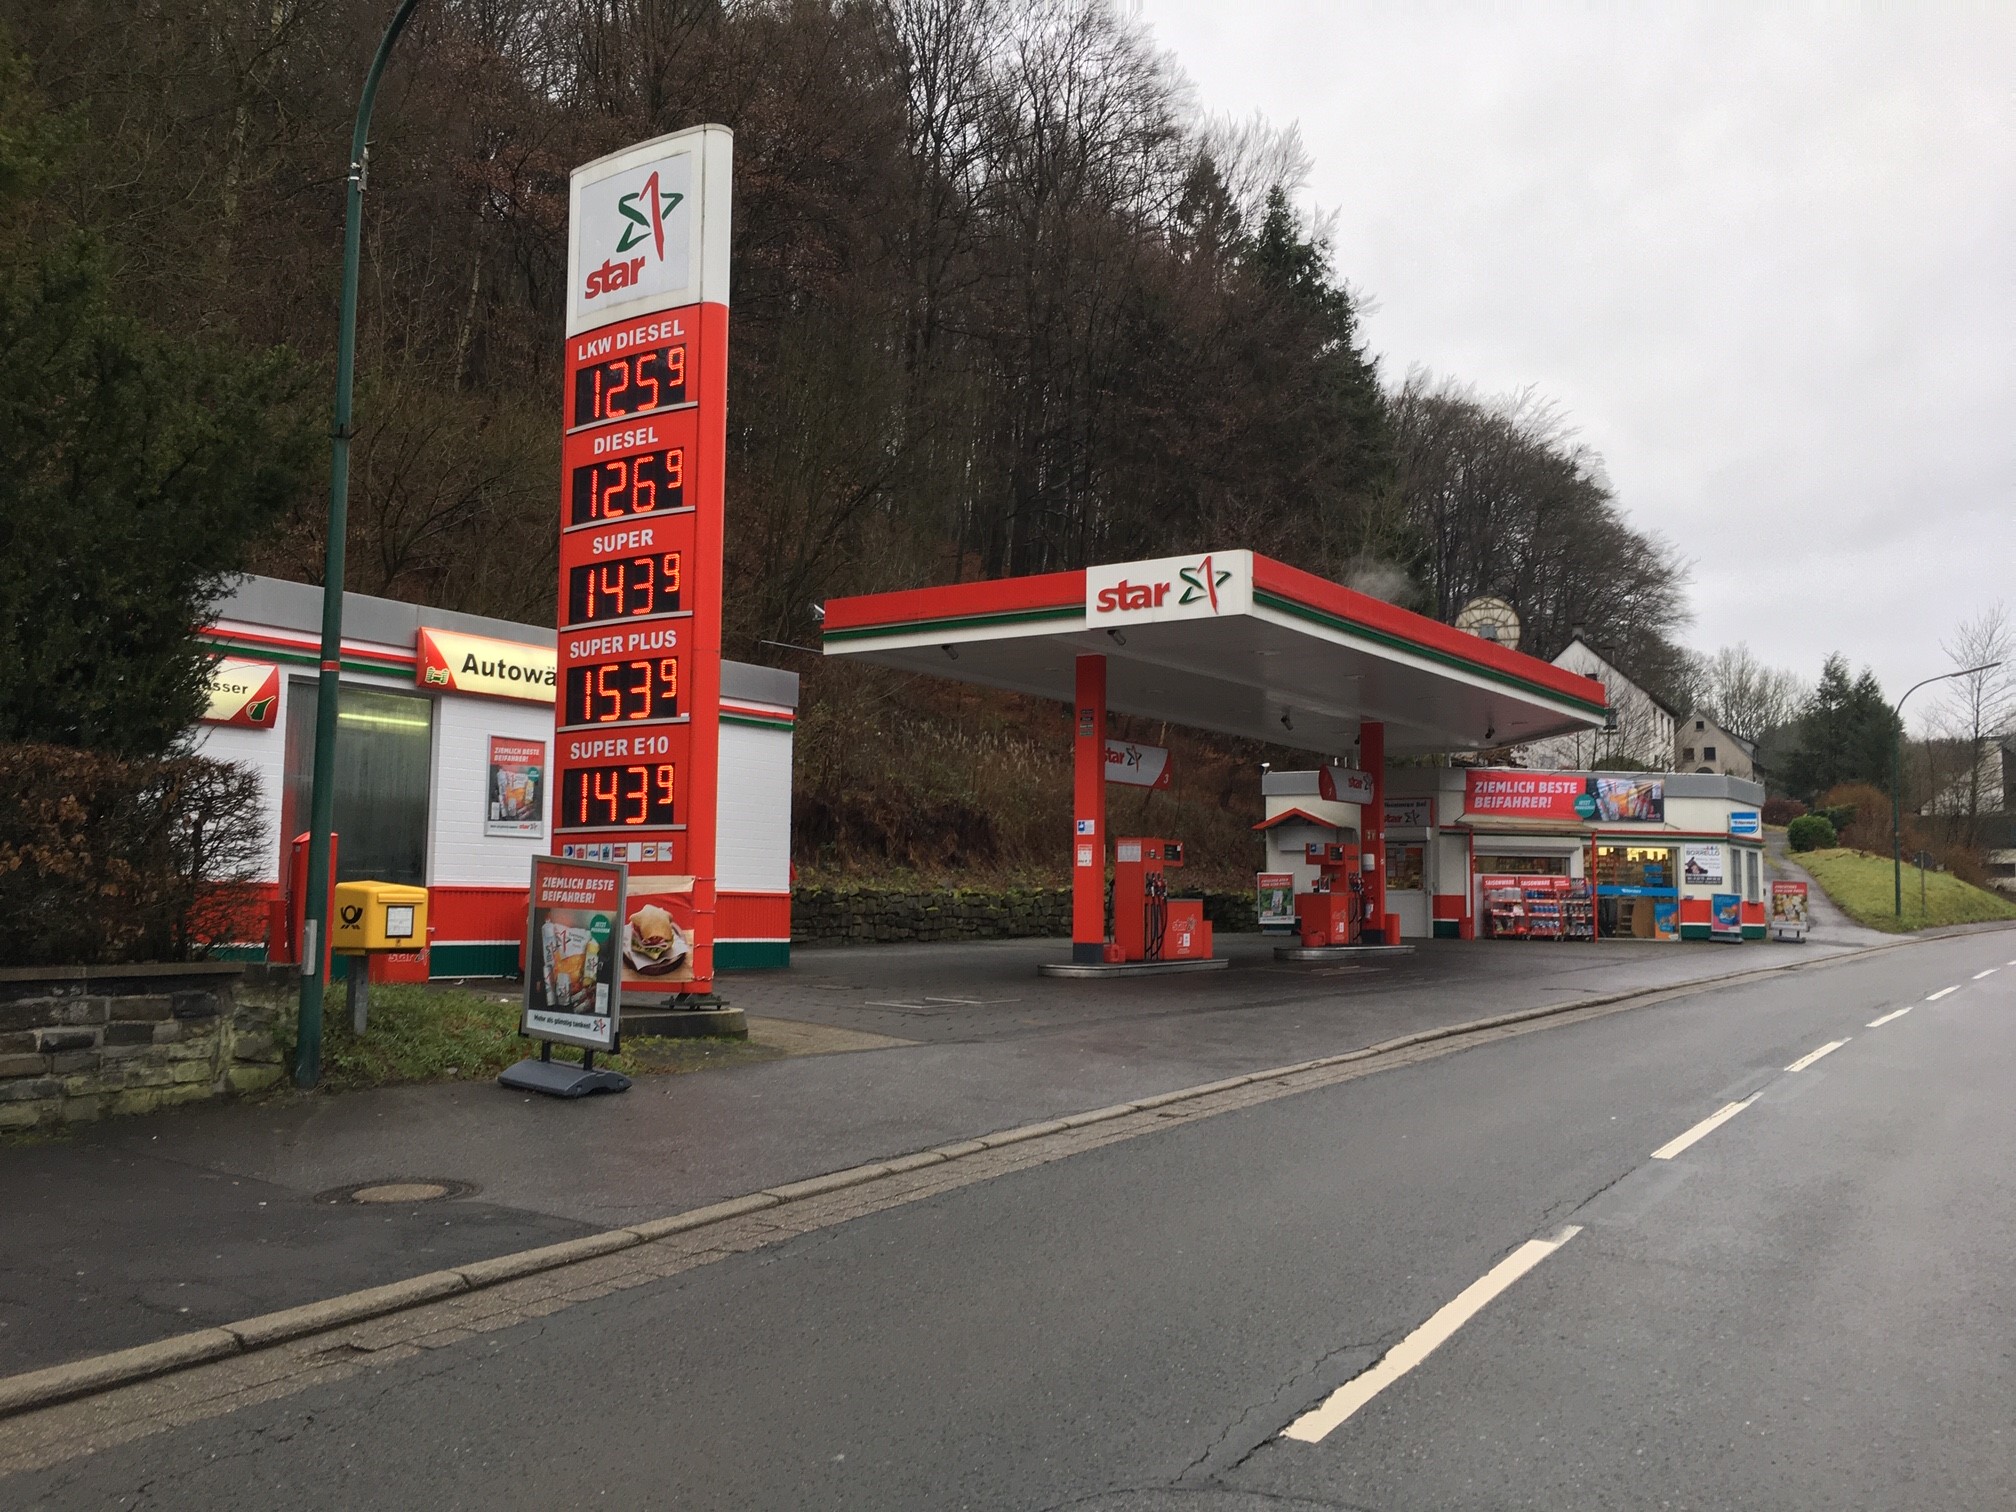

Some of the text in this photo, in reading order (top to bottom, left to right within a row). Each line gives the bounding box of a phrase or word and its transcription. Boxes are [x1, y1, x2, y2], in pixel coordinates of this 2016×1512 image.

[585, 256, 645, 299] star
[578, 319, 685, 361] LKW DIESEL
[593, 427, 659, 455] DIESEL
[592, 528, 654, 555] SUPER
[1096, 579, 1171, 612] star
[569, 630, 677, 659] SUPER PLUS
[494, 747, 521, 755] ZIEMLICH
[570, 736, 669, 760] SUPER E10
[1163, 774, 1169, 784] 3
[1347, 776, 1363, 789] star
[1475, 781, 1578, 794] ZIEMLICH BESTE
[1474, 796, 1552, 809] BEIFAHRER!
[542, 876, 615, 891] ZIEMLICH BESTE
[542, 890, 596, 904] BEIFAHRER!
